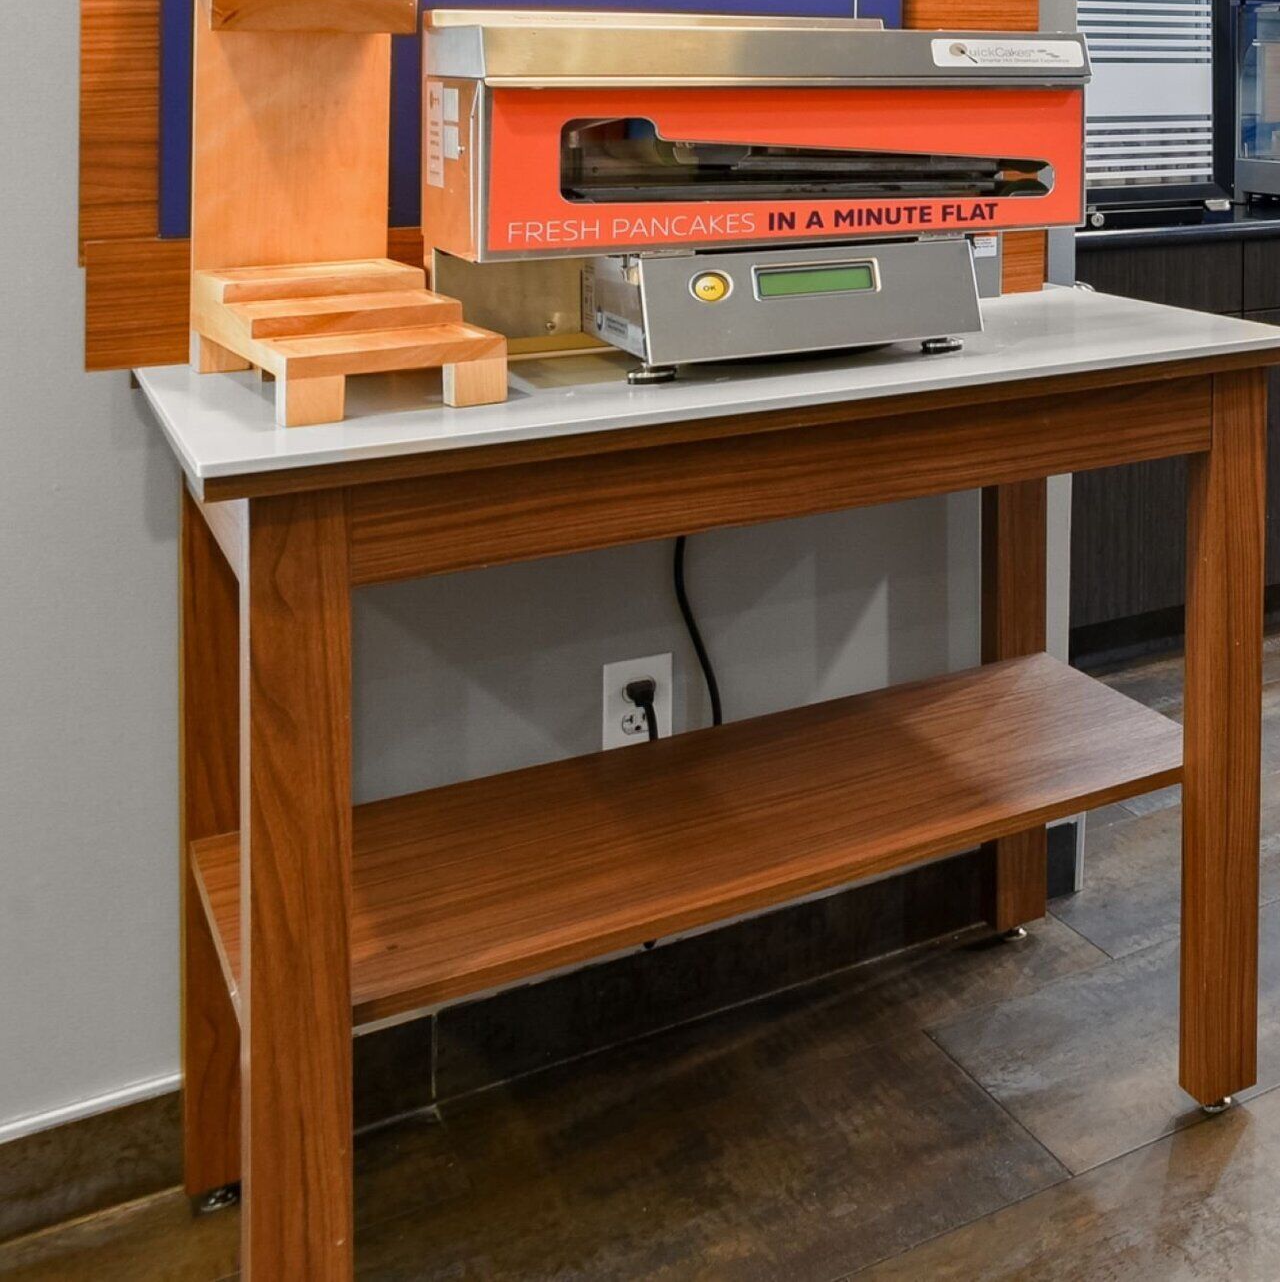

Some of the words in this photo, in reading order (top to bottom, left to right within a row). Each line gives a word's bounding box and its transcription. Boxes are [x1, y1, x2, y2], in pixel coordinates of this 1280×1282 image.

[508, 219, 600, 243] FRESH
[612, 213, 756, 239] PANCAKES
[768, 211, 796, 231] IN
[805, 210, 825, 229] A
[834, 205, 933, 228] MINUTE
[941, 203, 999, 222] FLAT
